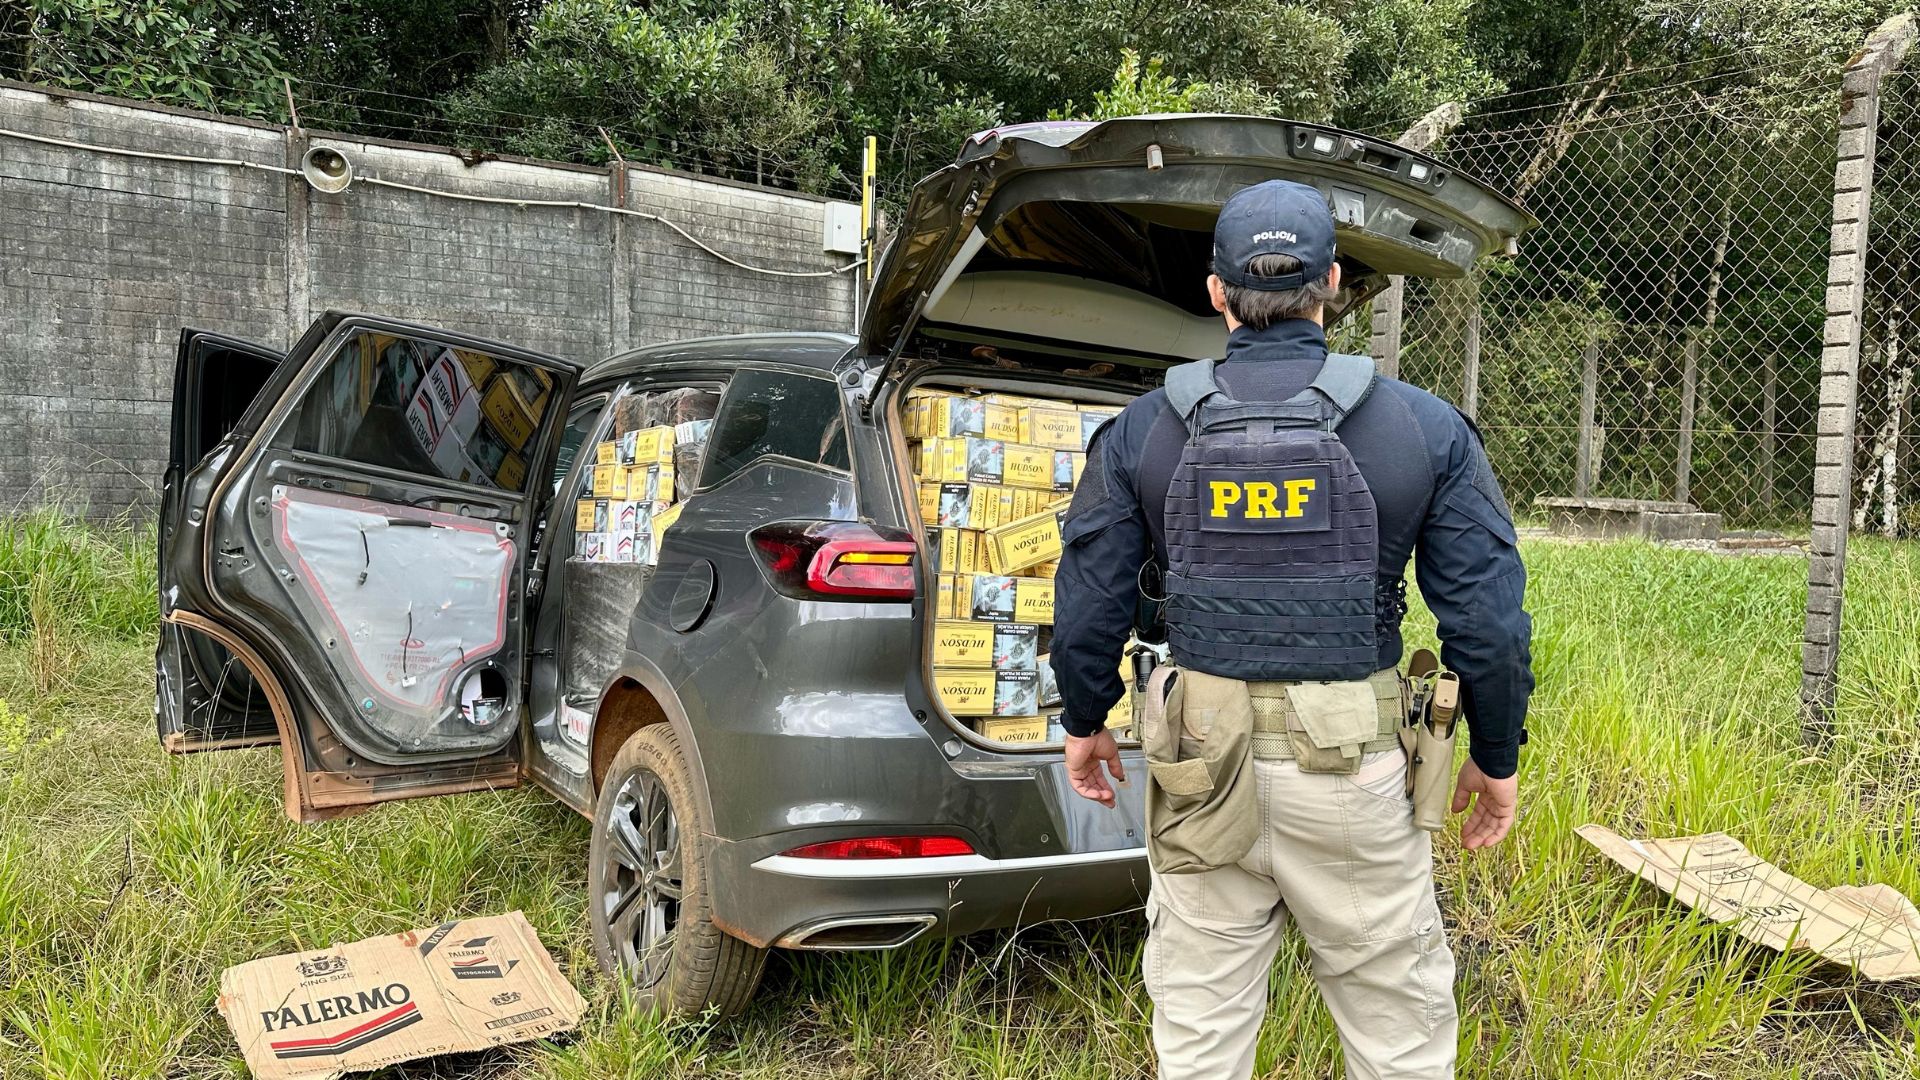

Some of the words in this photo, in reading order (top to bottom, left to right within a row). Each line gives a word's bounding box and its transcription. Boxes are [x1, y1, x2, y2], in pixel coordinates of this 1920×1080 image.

[1253, 230, 1297, 244] POLICIA
[991, 422, 1018, 433] HUDSO
[1043, 423, 1075, 433] HUDSON
[1010, 462, 1044, 472] HUDSON
[1209, 479, 1316, 518] PRF
[1013, 531, 1052, 552] HUDSON
[1024, 599, 1054, 607] HUDS
[940, 639, 986, 648] HUDSON
[942, 686, 987, 695] HUDSON
[427, 925, 449, 945] BOX
[300, 977, 327, 988] KING
[329, 972, 354, 982] SIZE
[261, 983, 411, 1032] PALERMO
